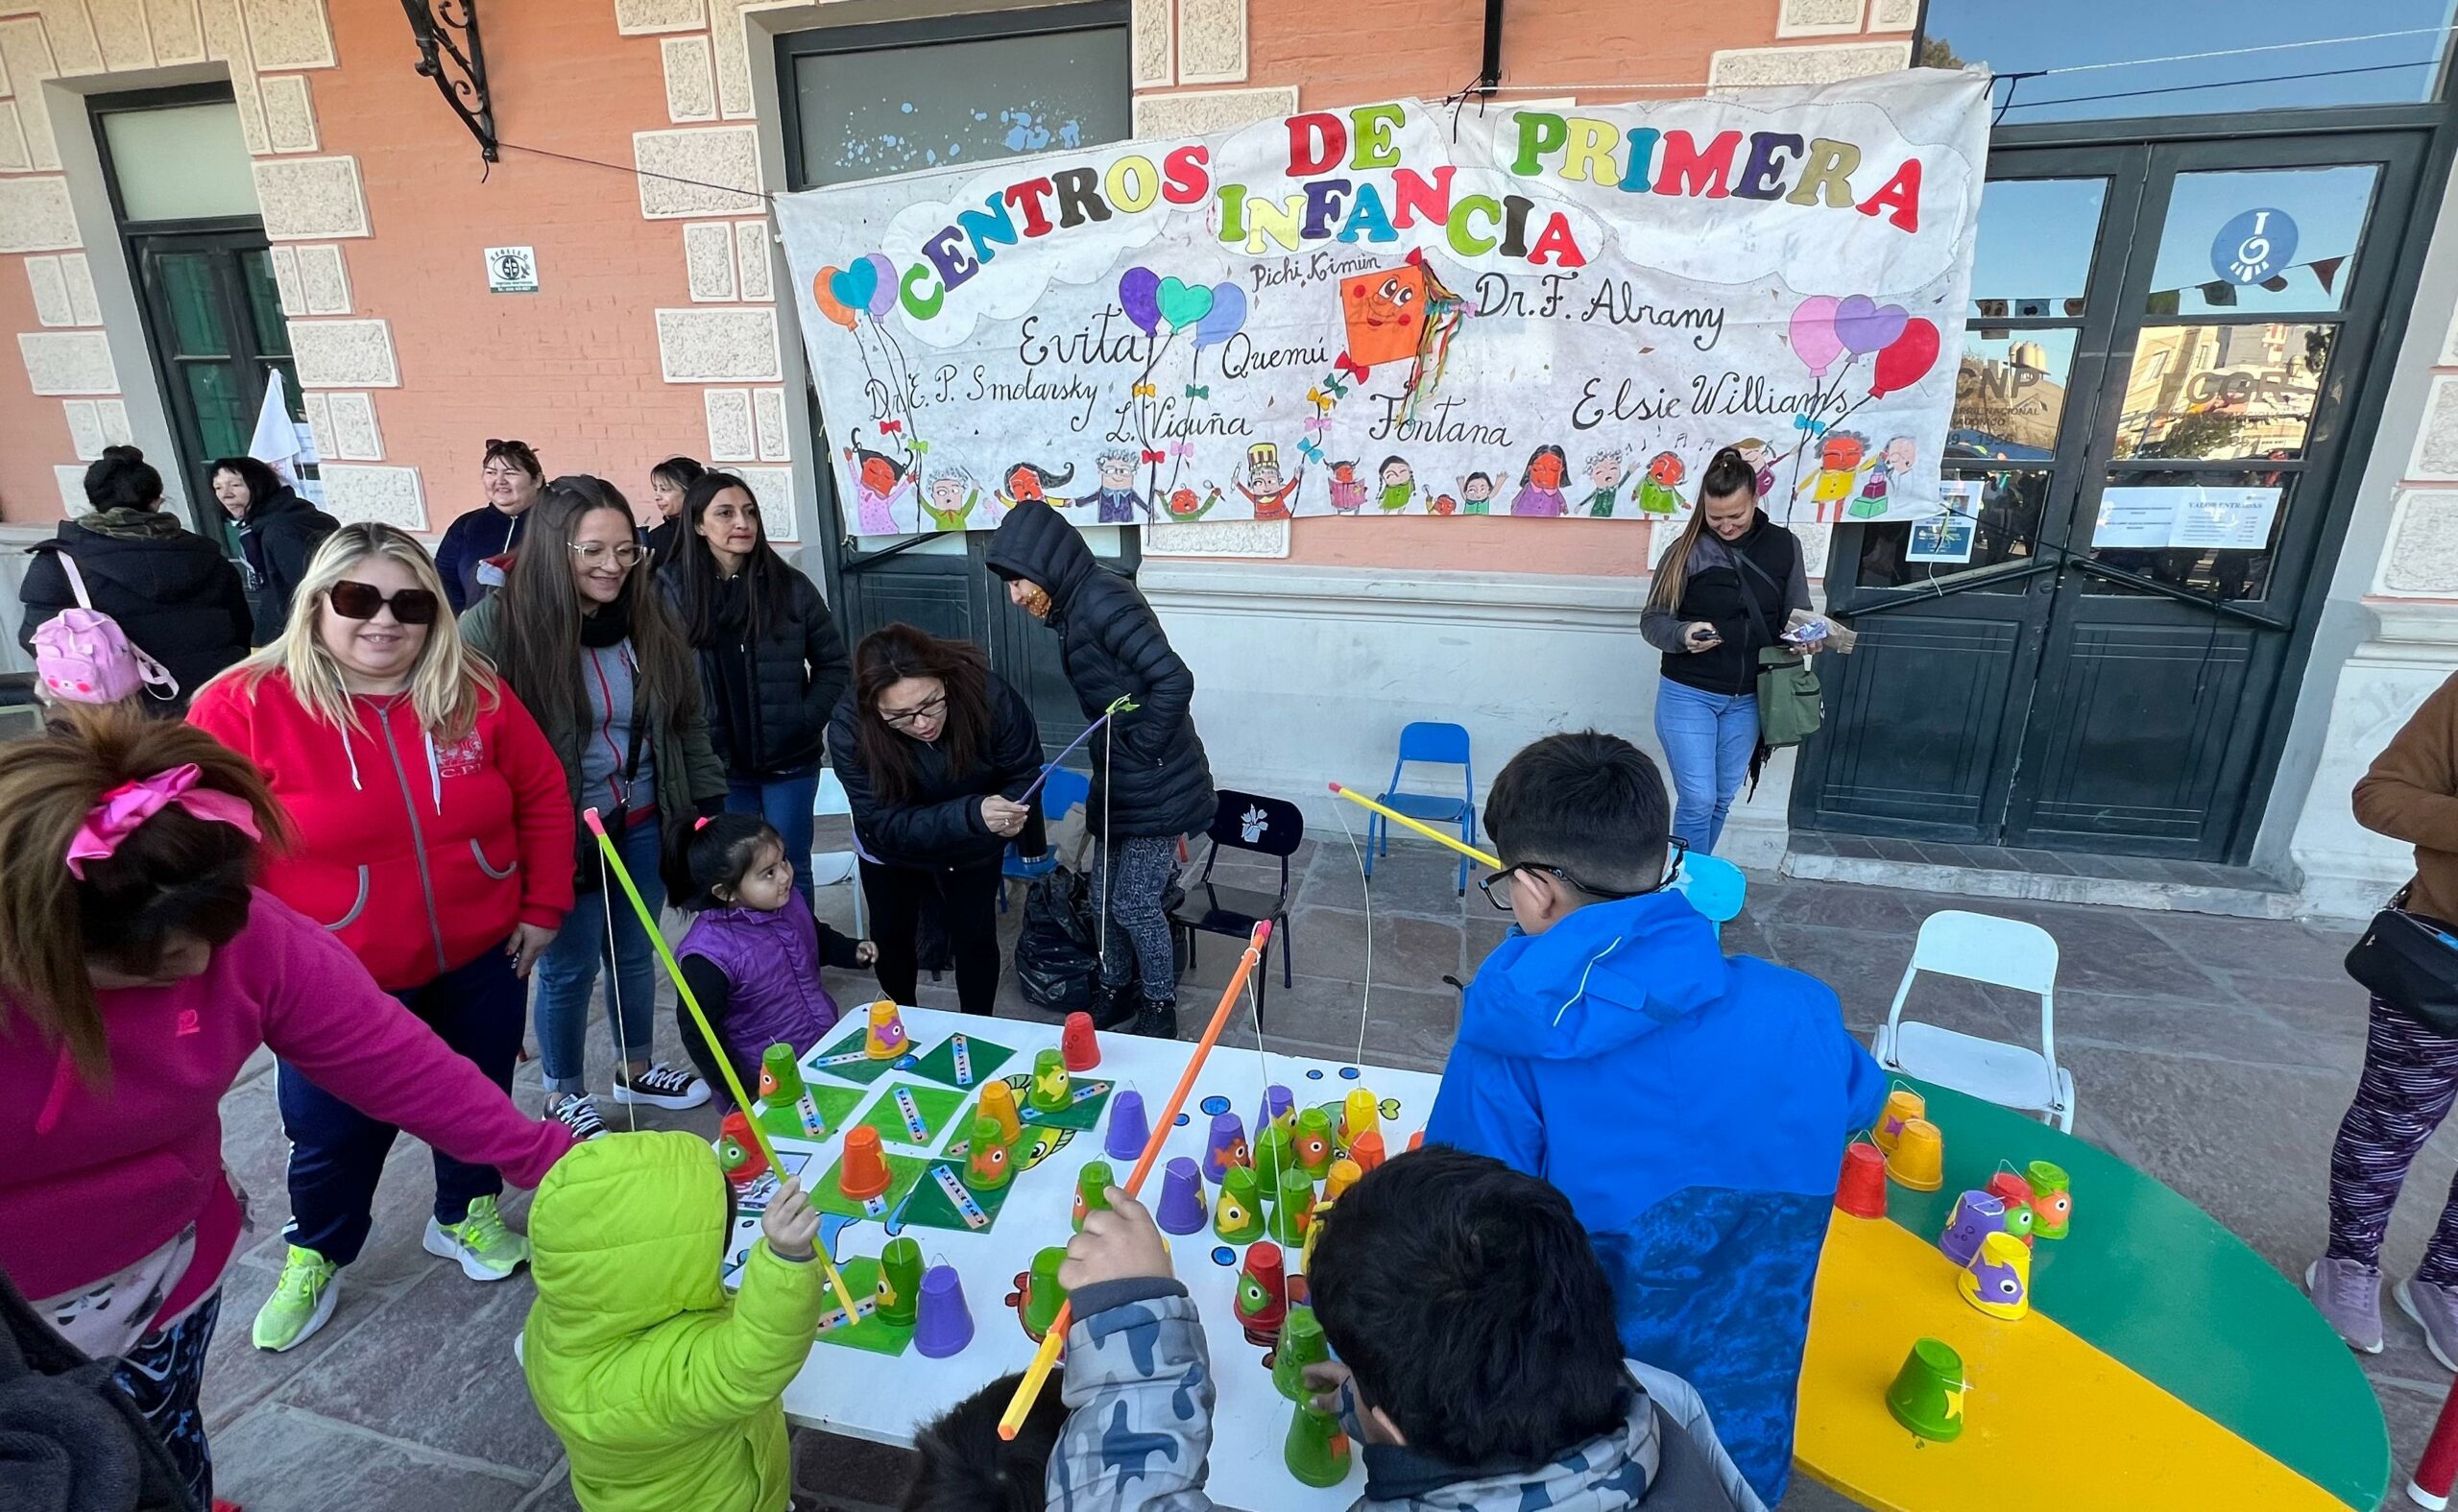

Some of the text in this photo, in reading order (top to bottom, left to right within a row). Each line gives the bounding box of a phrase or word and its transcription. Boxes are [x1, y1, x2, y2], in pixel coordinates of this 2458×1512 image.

[900, 104, 1922, 321] CENTROS DE PRIMERA
[1216, 165, 1586, 268] INFANCIA
[1250, 255, 1303, 294] Pichi
[1019, 305, 1146, 366] Evita
[1222, 332, 1329, 379] Quemú
[934, 364, 955, 403] P.
[966, 364, 1098, 432] Smolarsky
[1105, 400, 1136, 443] L.
[1368, 380, 1514, 447] Fontana
[1572, 371, 1848, 431] Elsie Williams
